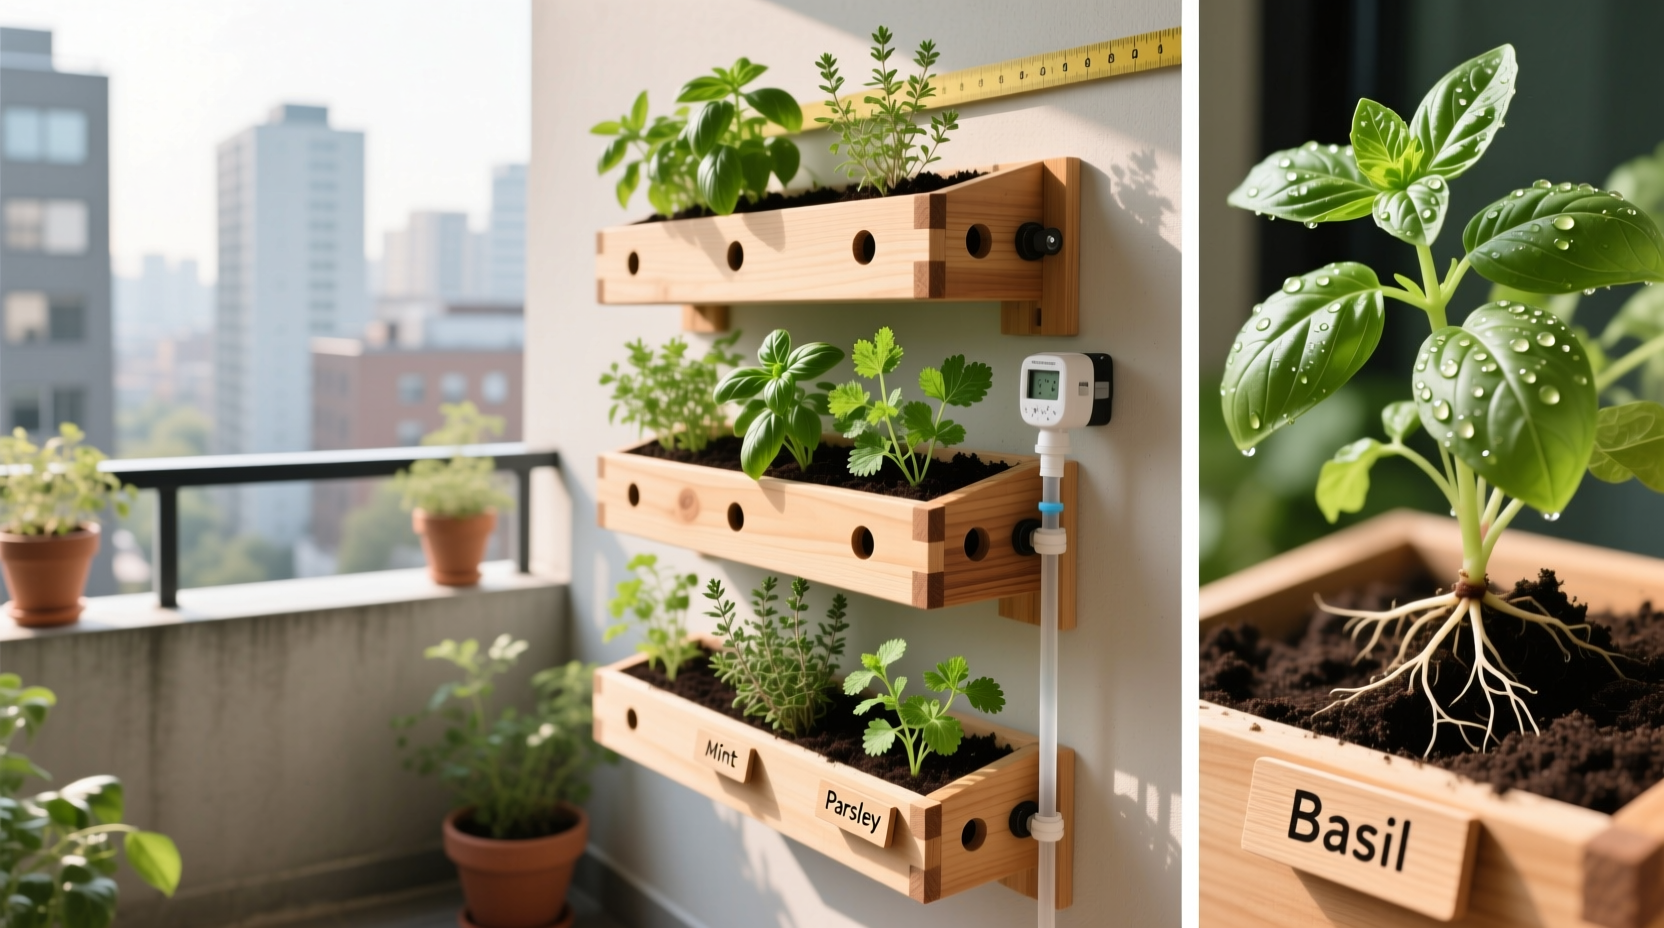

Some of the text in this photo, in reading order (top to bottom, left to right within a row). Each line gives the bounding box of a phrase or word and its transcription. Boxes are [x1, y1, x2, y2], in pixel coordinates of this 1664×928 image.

[705, 739, 738, 768] Mint
[825, 789, 882, 835] Parsley
[1287, 788, 1412, 873] Basil
